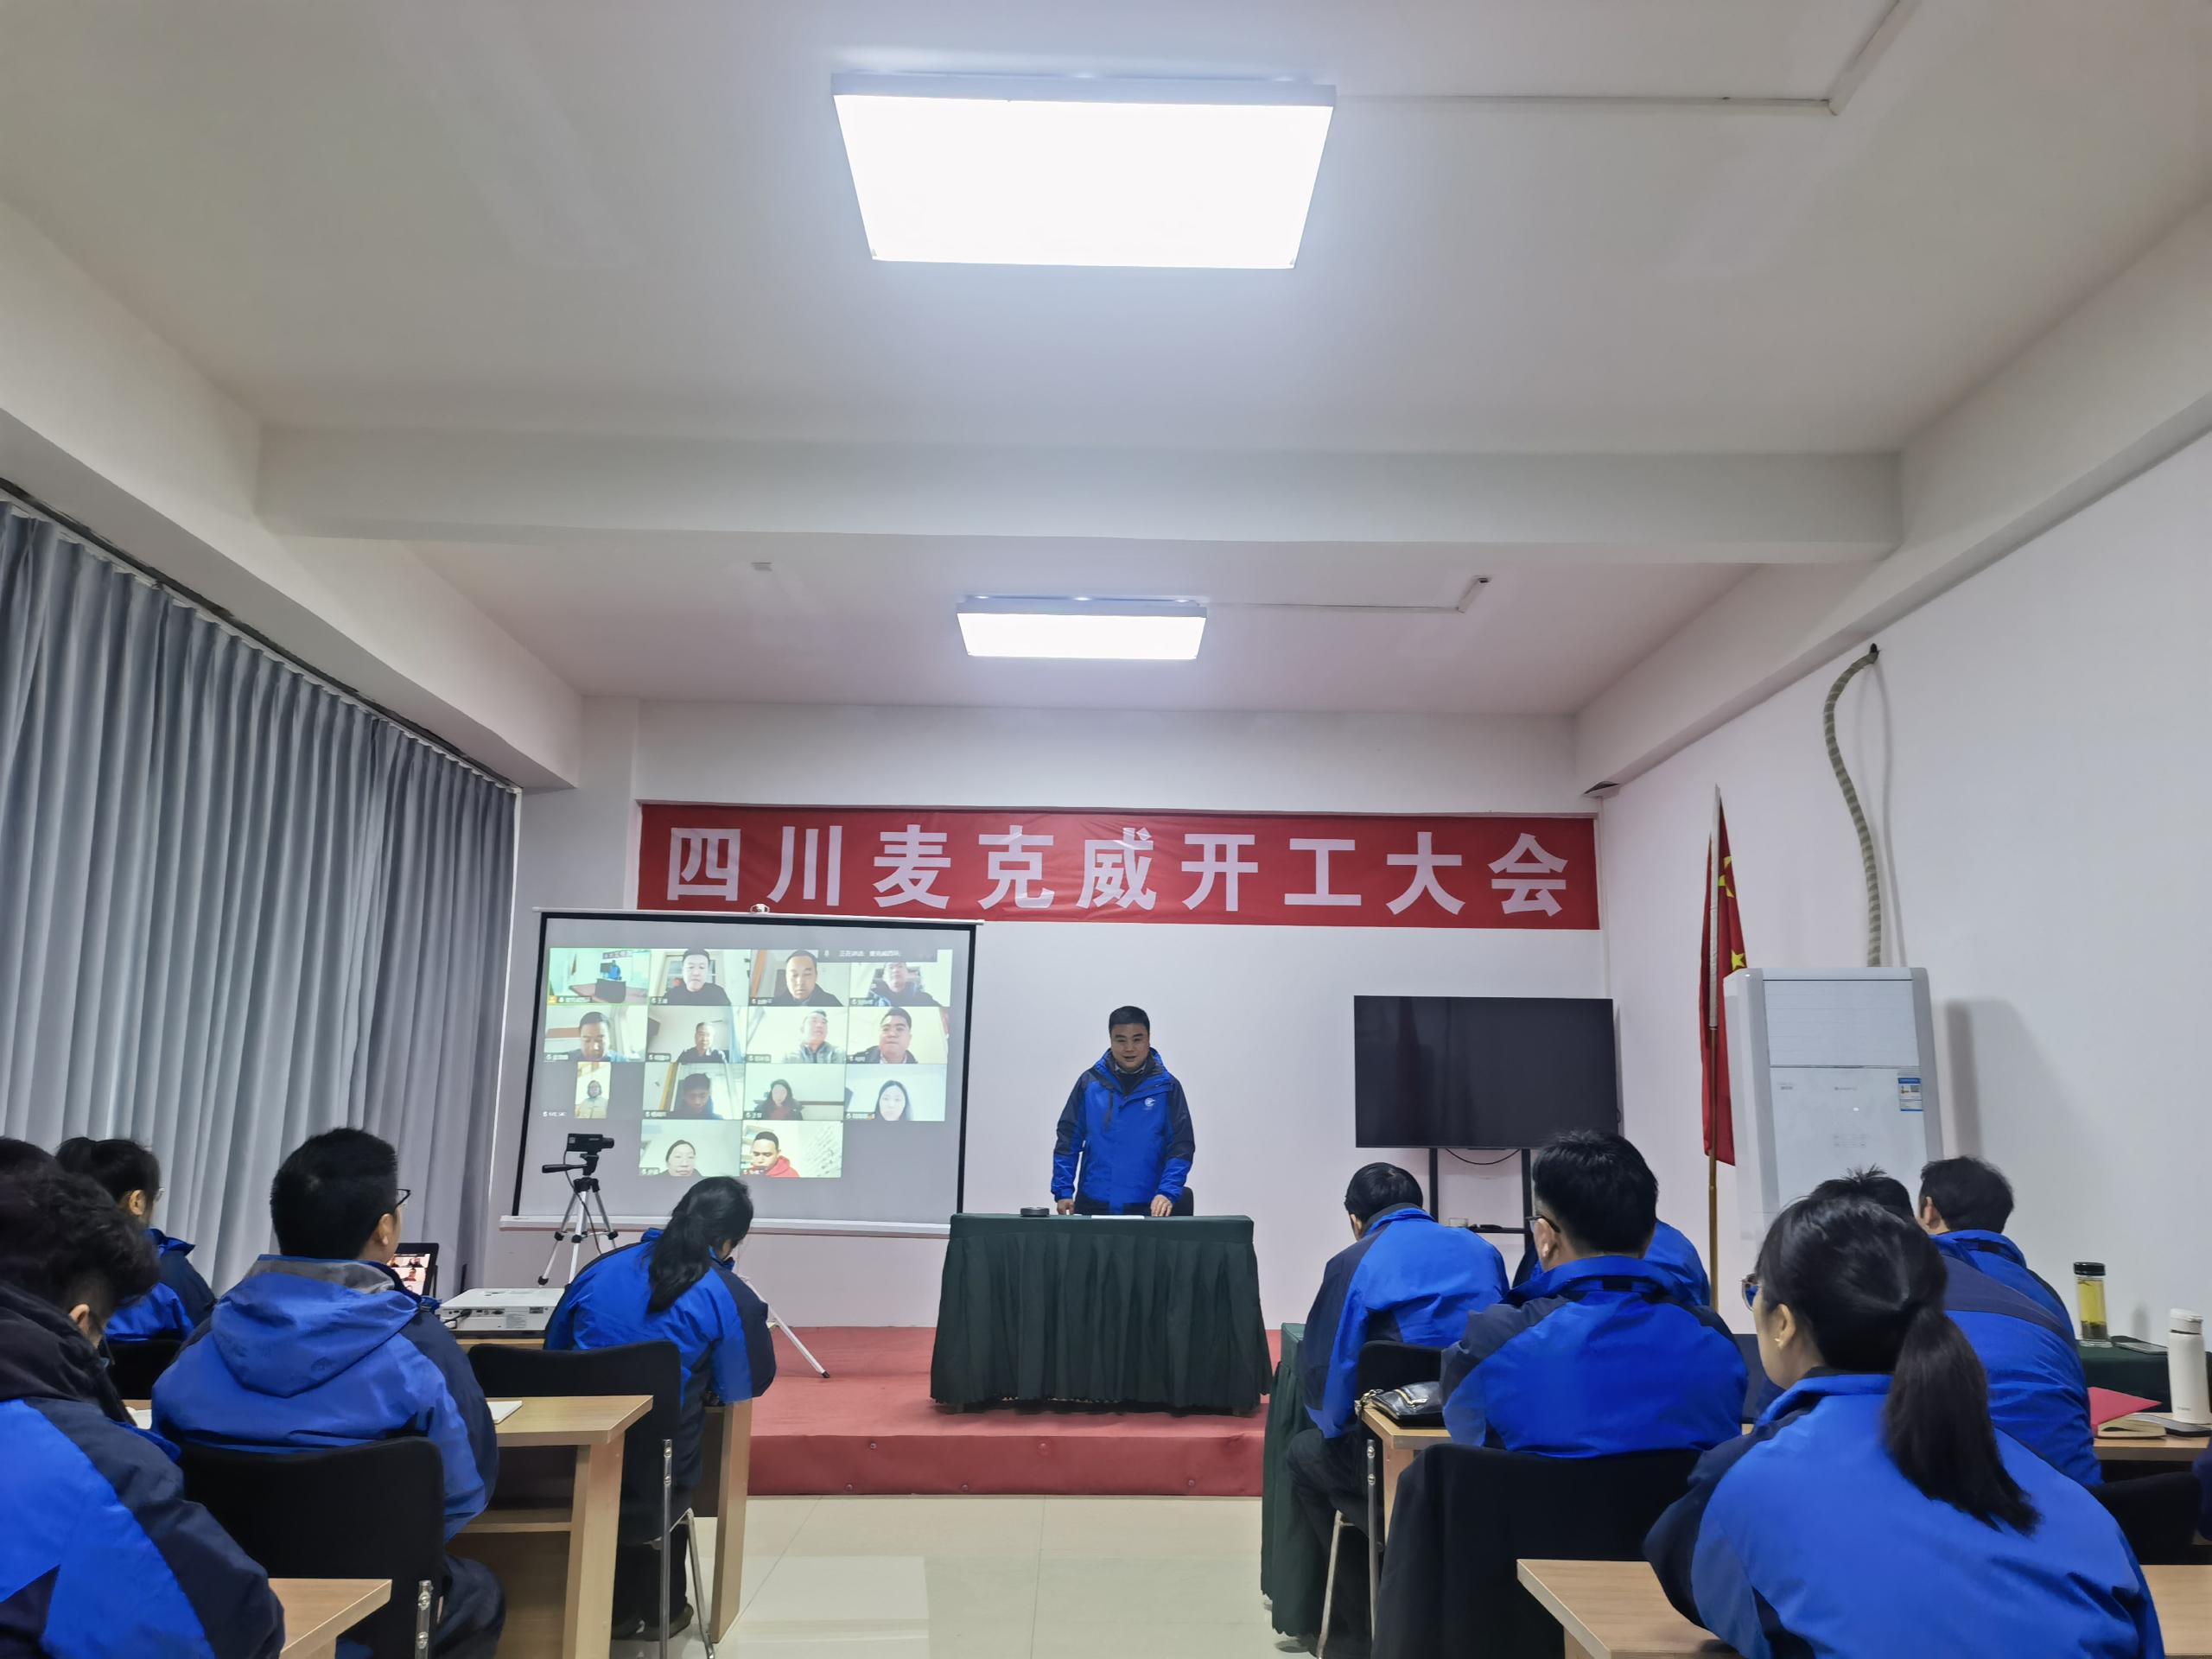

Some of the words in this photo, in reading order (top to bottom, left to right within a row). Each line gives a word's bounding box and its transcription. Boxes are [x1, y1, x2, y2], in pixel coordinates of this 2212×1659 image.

[666, 824, 1568, 917] 四川麦克威开工大会
